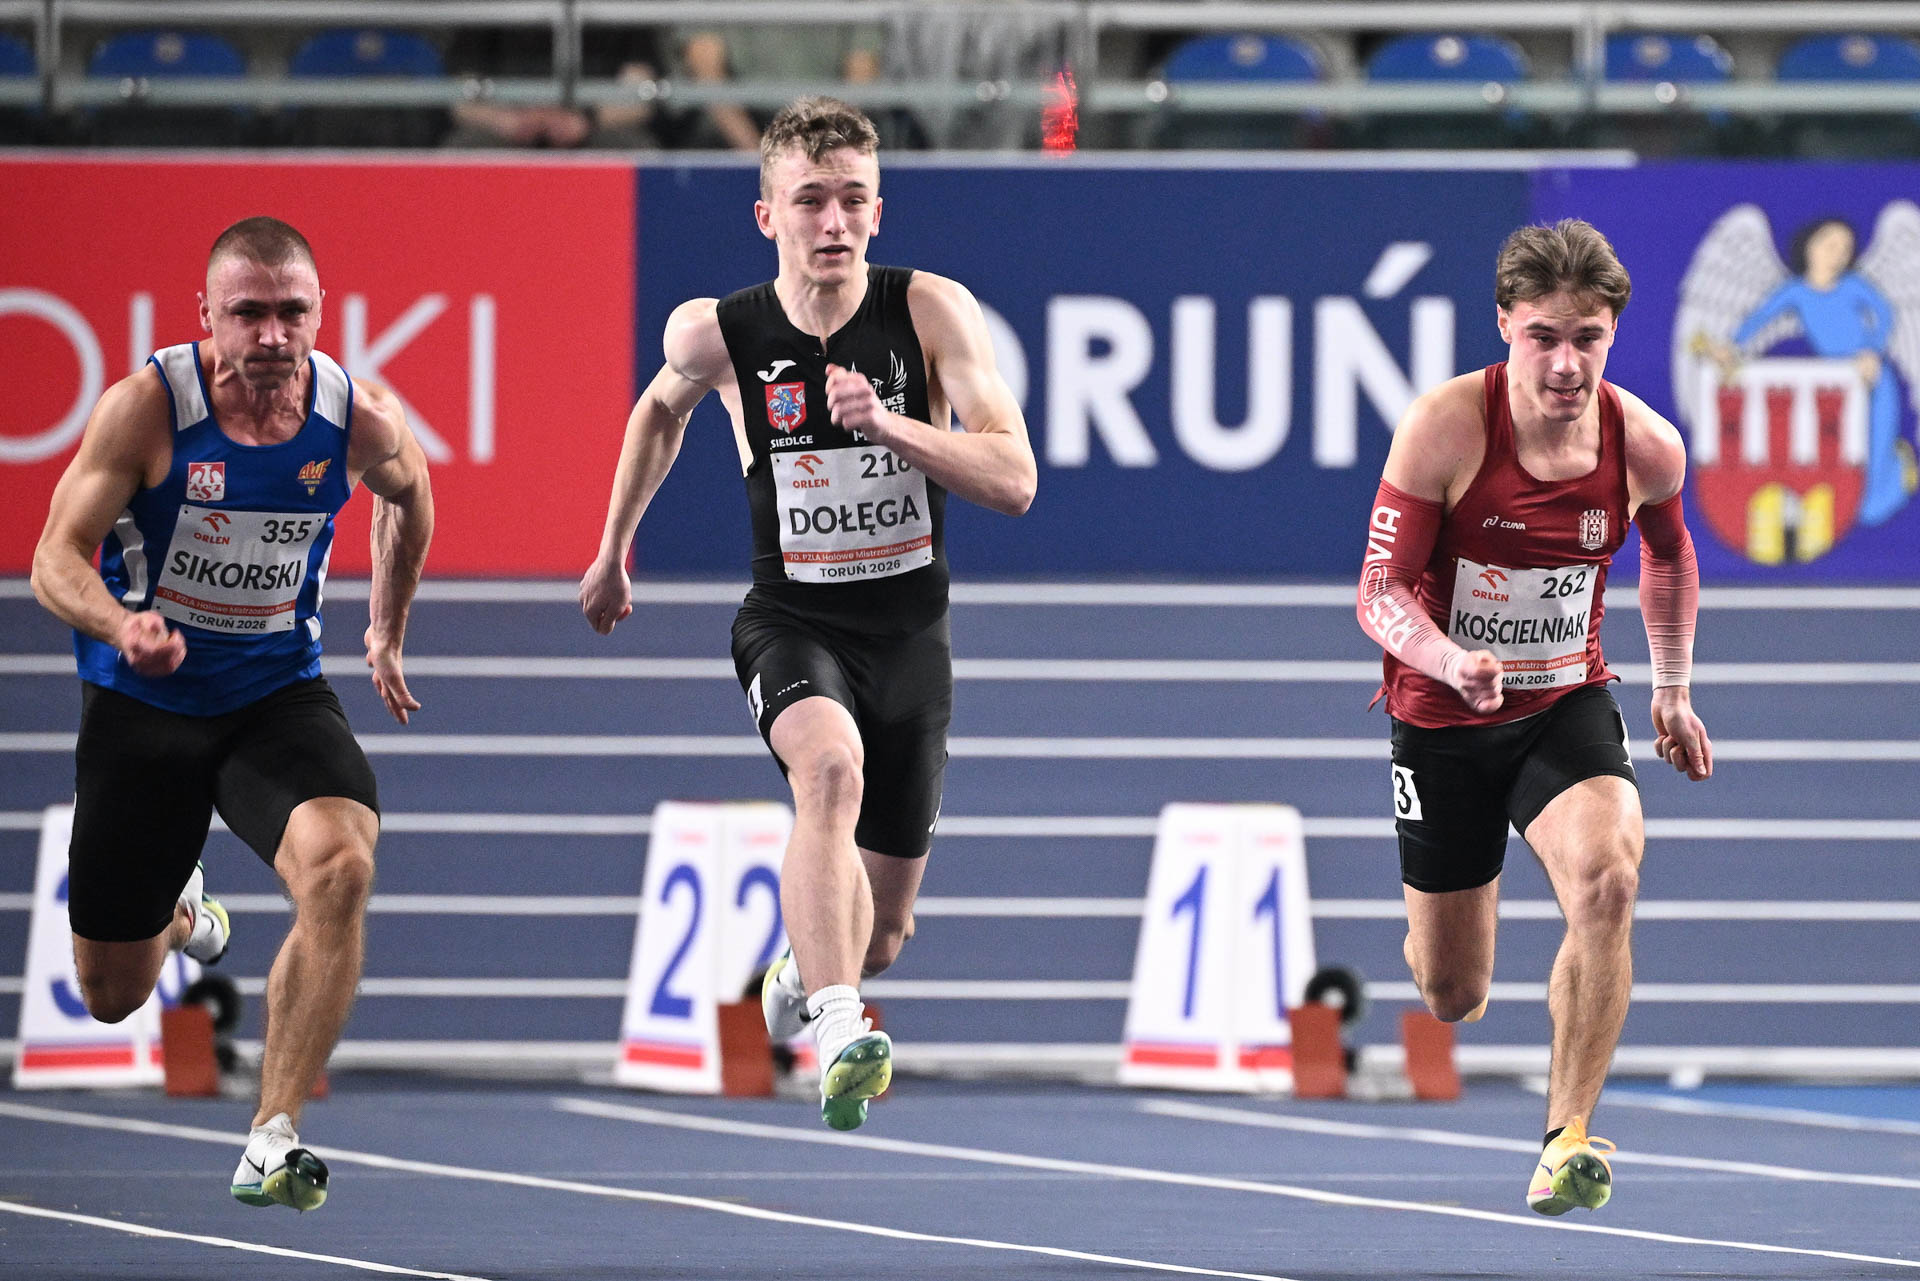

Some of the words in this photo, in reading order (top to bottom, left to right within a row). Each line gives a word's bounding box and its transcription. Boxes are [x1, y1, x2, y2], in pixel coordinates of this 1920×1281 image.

[951, 241, 1456, 472] RUŃ
[0, 287, 498, 463] OKI
[770, 435, 814, 449] SIEDLCE
[792, 478, 829, 489] ORLEN
[789, 494, 921, 536] DOŁĘGA
[194, 532, 230, 545] ORLEN
[261, 519, 312, 545] 355
[790, 553, 801, 561] 70.
[803, 553, 822, 561] PZLA
[856, 546, 905, 558] Mistrzostwa
[906, 539, 927, 549] Polski
[170, 550, 302, 591] SIKORSKI
[820, 562, 867, 577] TORUŃ
[870, 559, 901, 573] 2026
[1472, 589, 1509, 602] ORLEN
[1540, 570, 1586, 599] 262
[176, 593, 195, 605] PZLA
[229, 606, 275, 616] Mistrzostwa
[189, 612, 235, 629] TORUŃ
[237, 620, 267, 630] 2026
[1454, 610, 1587, 645] KOŚCIELNIAK
[1562, 653, 1582, 665] Polski
[1527, 673, 1556, 685] 2026
[1394, 769, 1412, 815] 3
[650, 863, 705, 1019] 2
[1171, 863, 1208, 1019] 1
[1254, 864, 1286, 1020] 1
